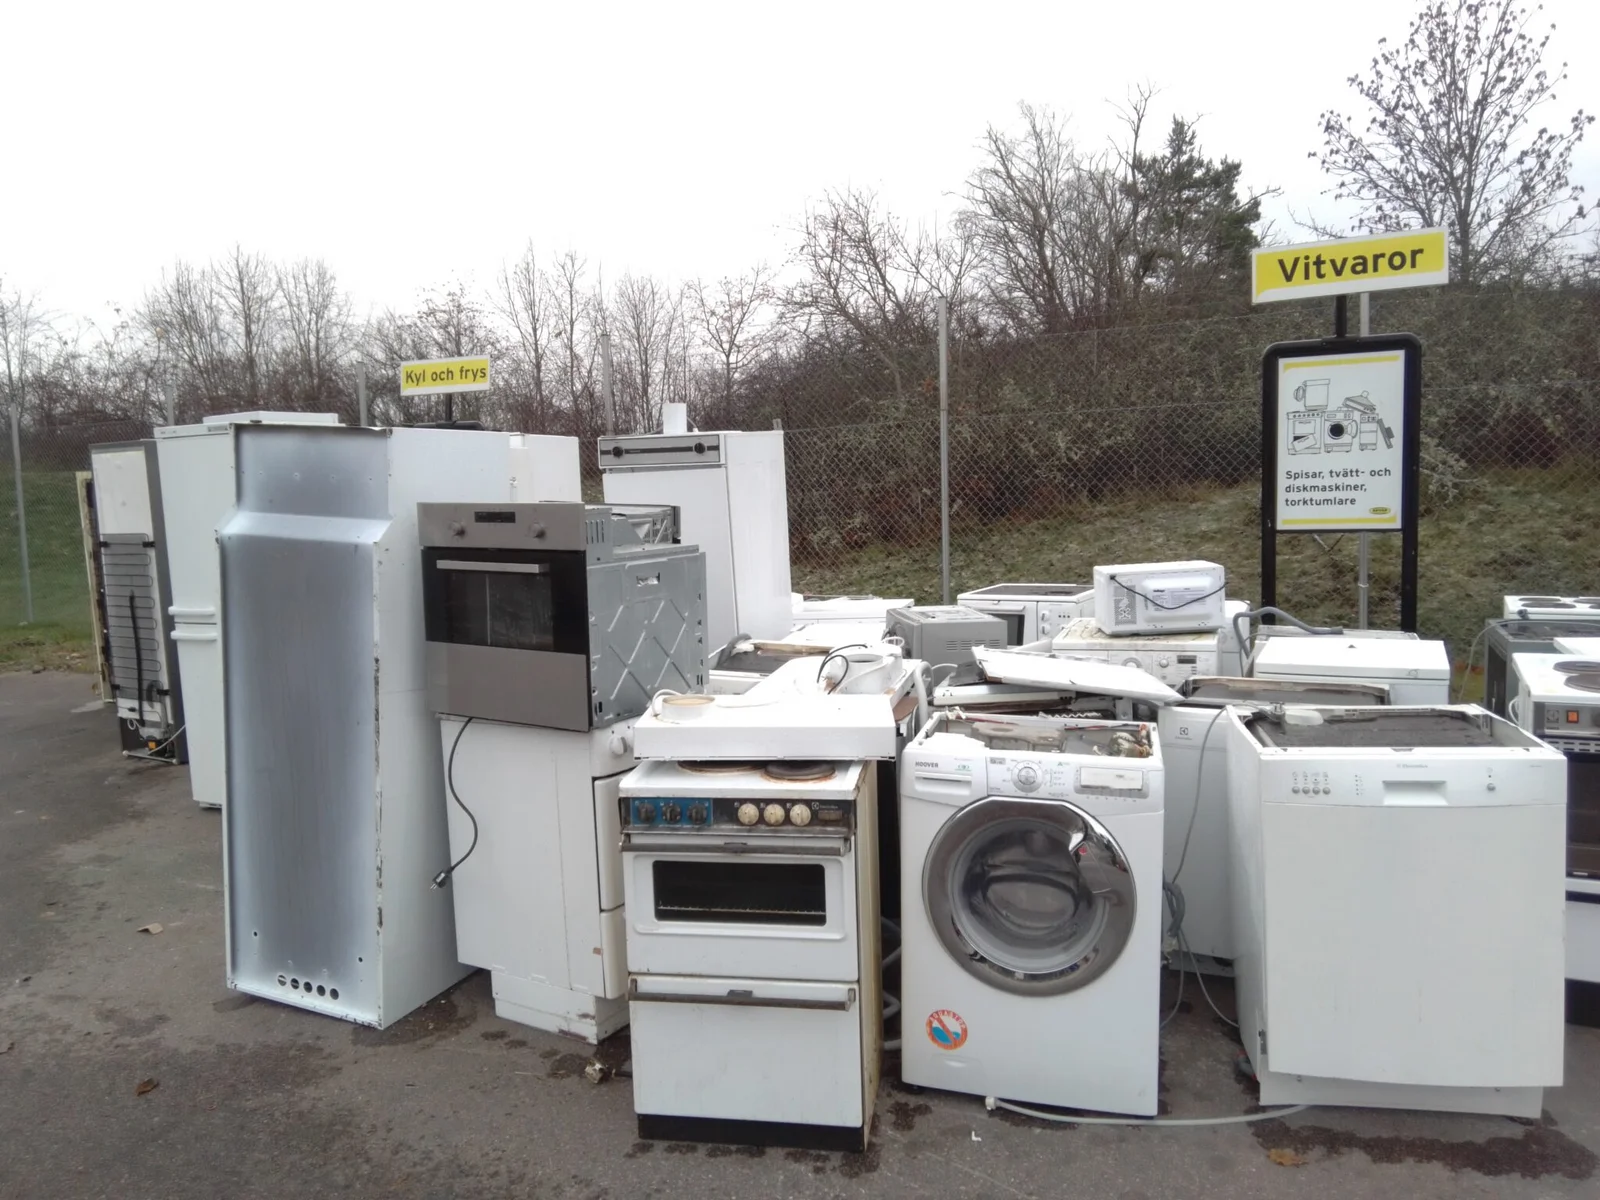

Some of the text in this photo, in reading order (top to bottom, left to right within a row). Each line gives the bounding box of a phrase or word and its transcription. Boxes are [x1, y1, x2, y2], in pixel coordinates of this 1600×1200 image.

[1277, 248, 1424, 283] Vitvaror
[405, 366, 487, 386] Kyl och frys
[1285, 467, 1392, 481] Spisar, tvätt- och
[1284, 483, 1367, 493] diskmaskiner,
[1284, 497, 1357, 506] torktumlare
